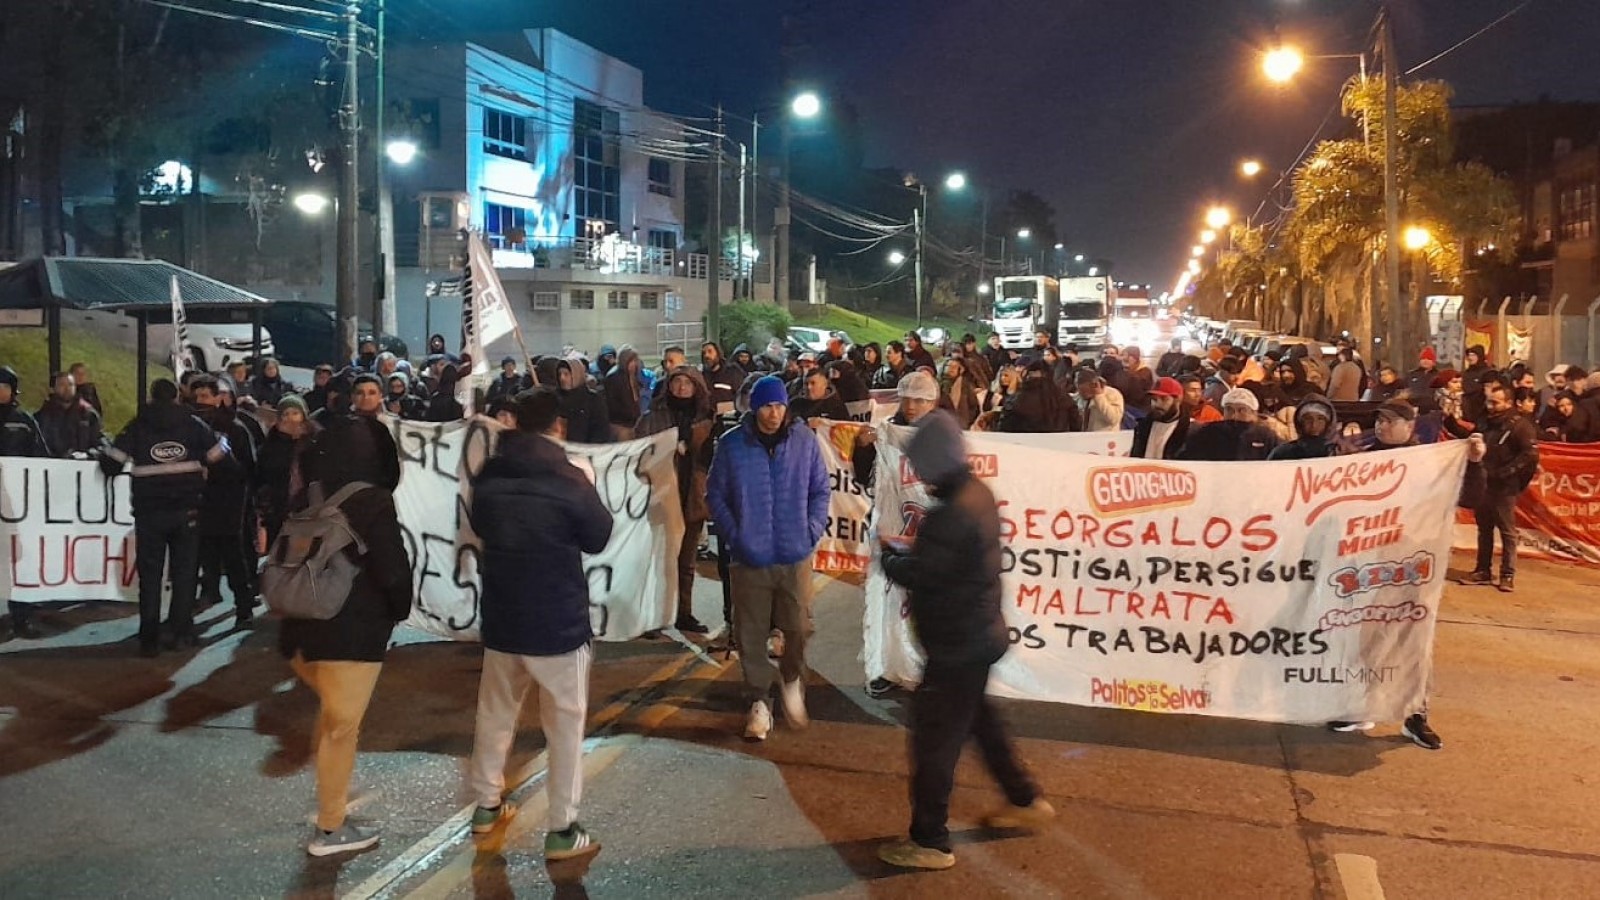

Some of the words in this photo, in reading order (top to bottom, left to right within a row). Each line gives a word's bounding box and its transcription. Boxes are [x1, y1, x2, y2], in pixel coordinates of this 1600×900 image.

[44, 469, 133, 525] LUC
[1093, 471, 1195, 505] GEORGALOS
[1346, 506, 1402, 536] Full
[1016, 583, 1236, 625] MALTRATA
[1054, 622, 1328, 663] TRABAJADORES
[1091, 677, 1145, 707] Palitos
[1160, 683, 1207, 710] Selva
